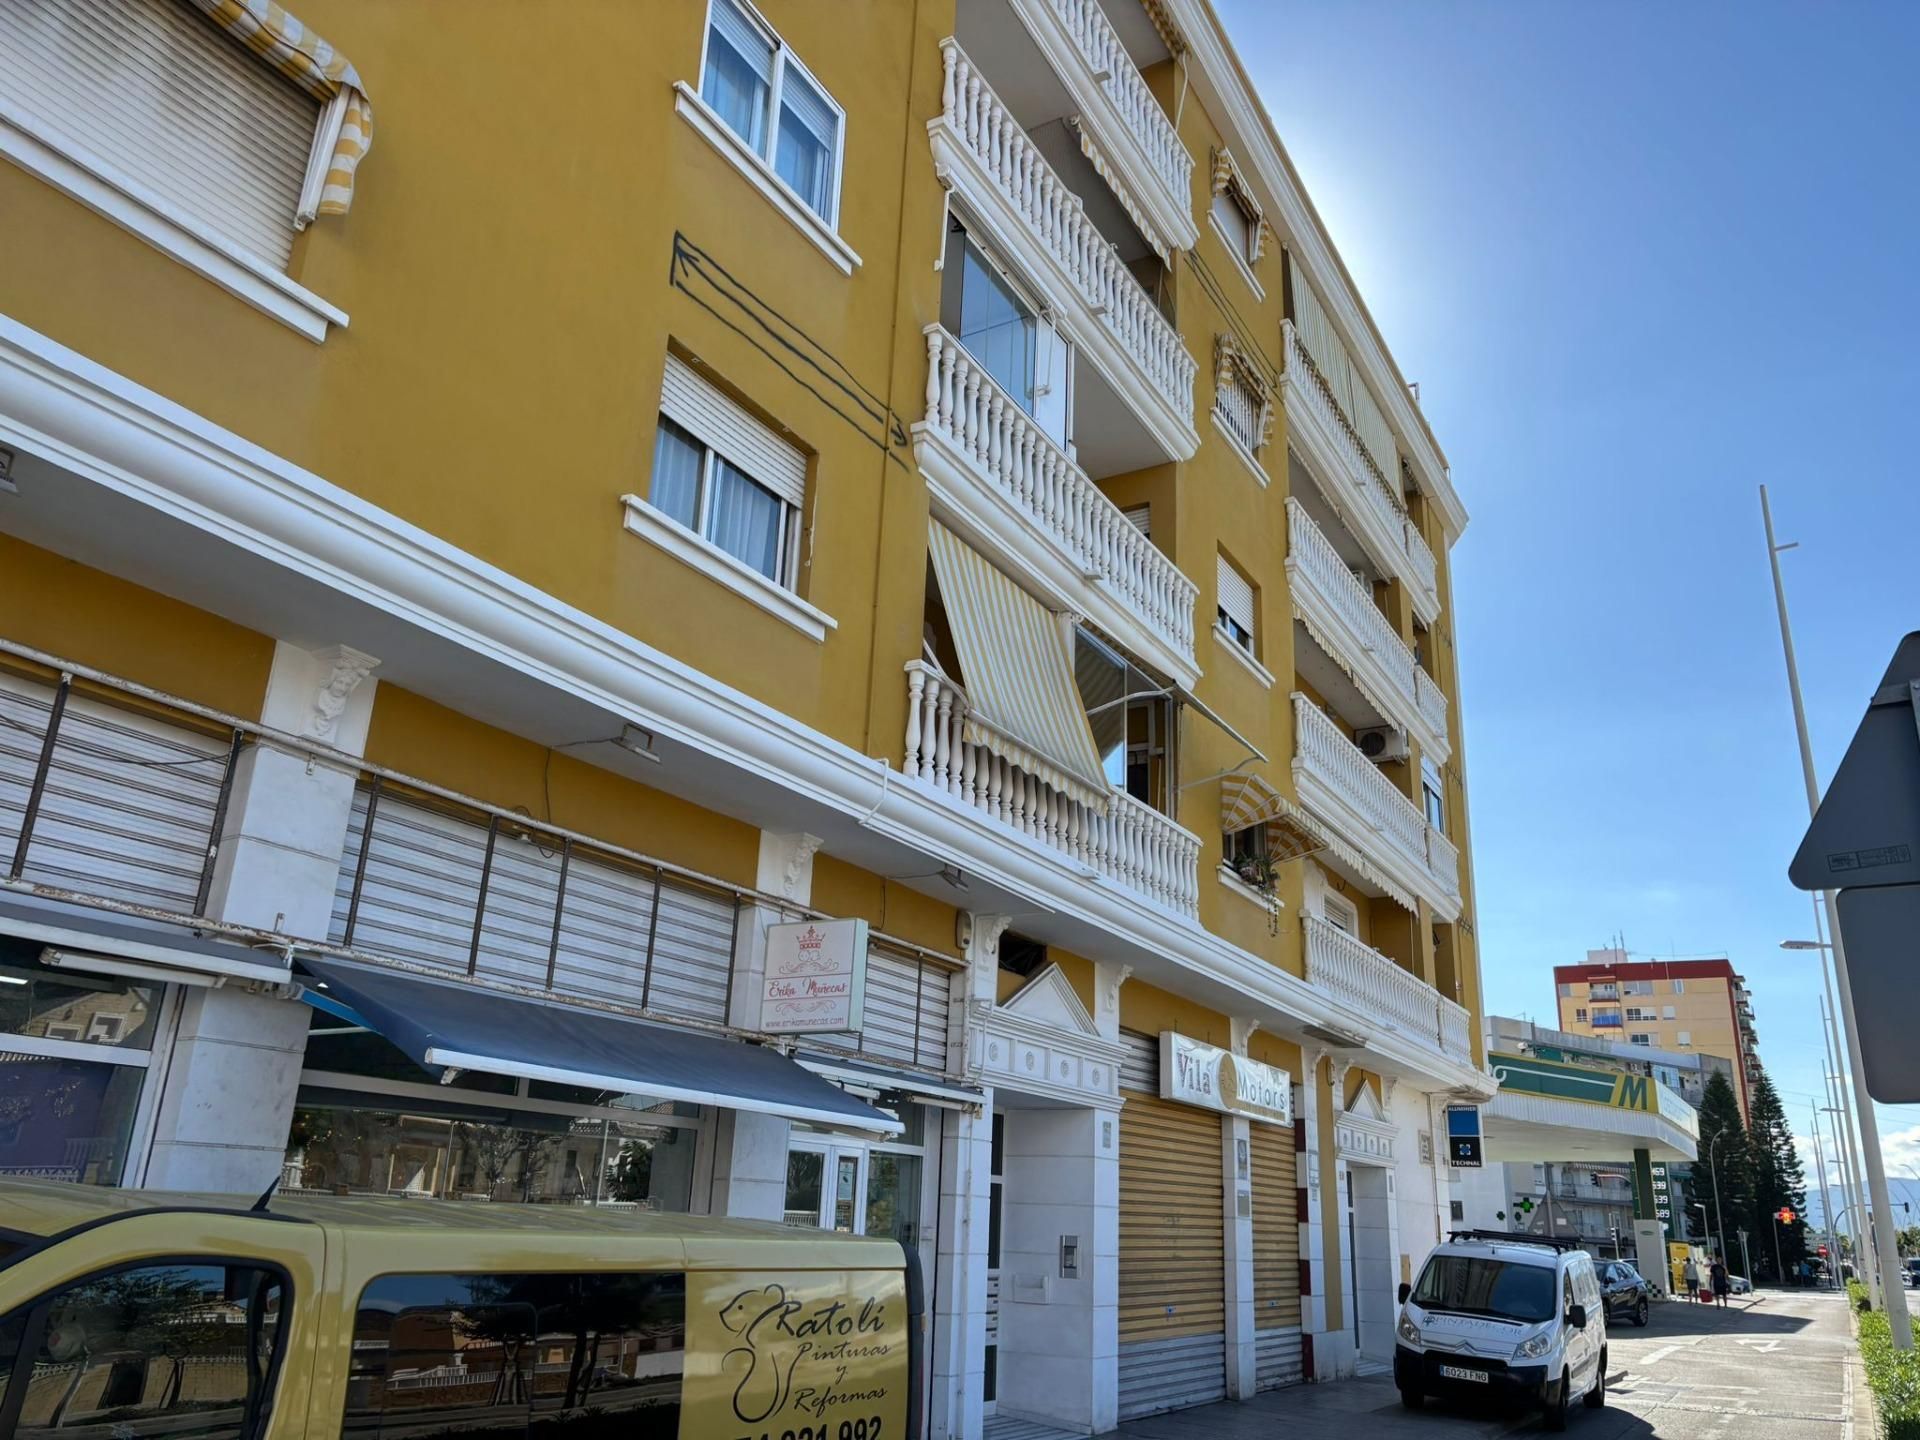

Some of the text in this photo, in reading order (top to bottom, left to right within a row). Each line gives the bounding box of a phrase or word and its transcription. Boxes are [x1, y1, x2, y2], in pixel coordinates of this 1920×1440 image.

[768, 981, 796, 997] Erika
[1238, 1072, 1285, 1110] Motors
[797, 1341, 891, 1361] Pinturas
[1445, 1367, 1467, 1378] 6023
[794, 1386, 888, 1418] Reformas
